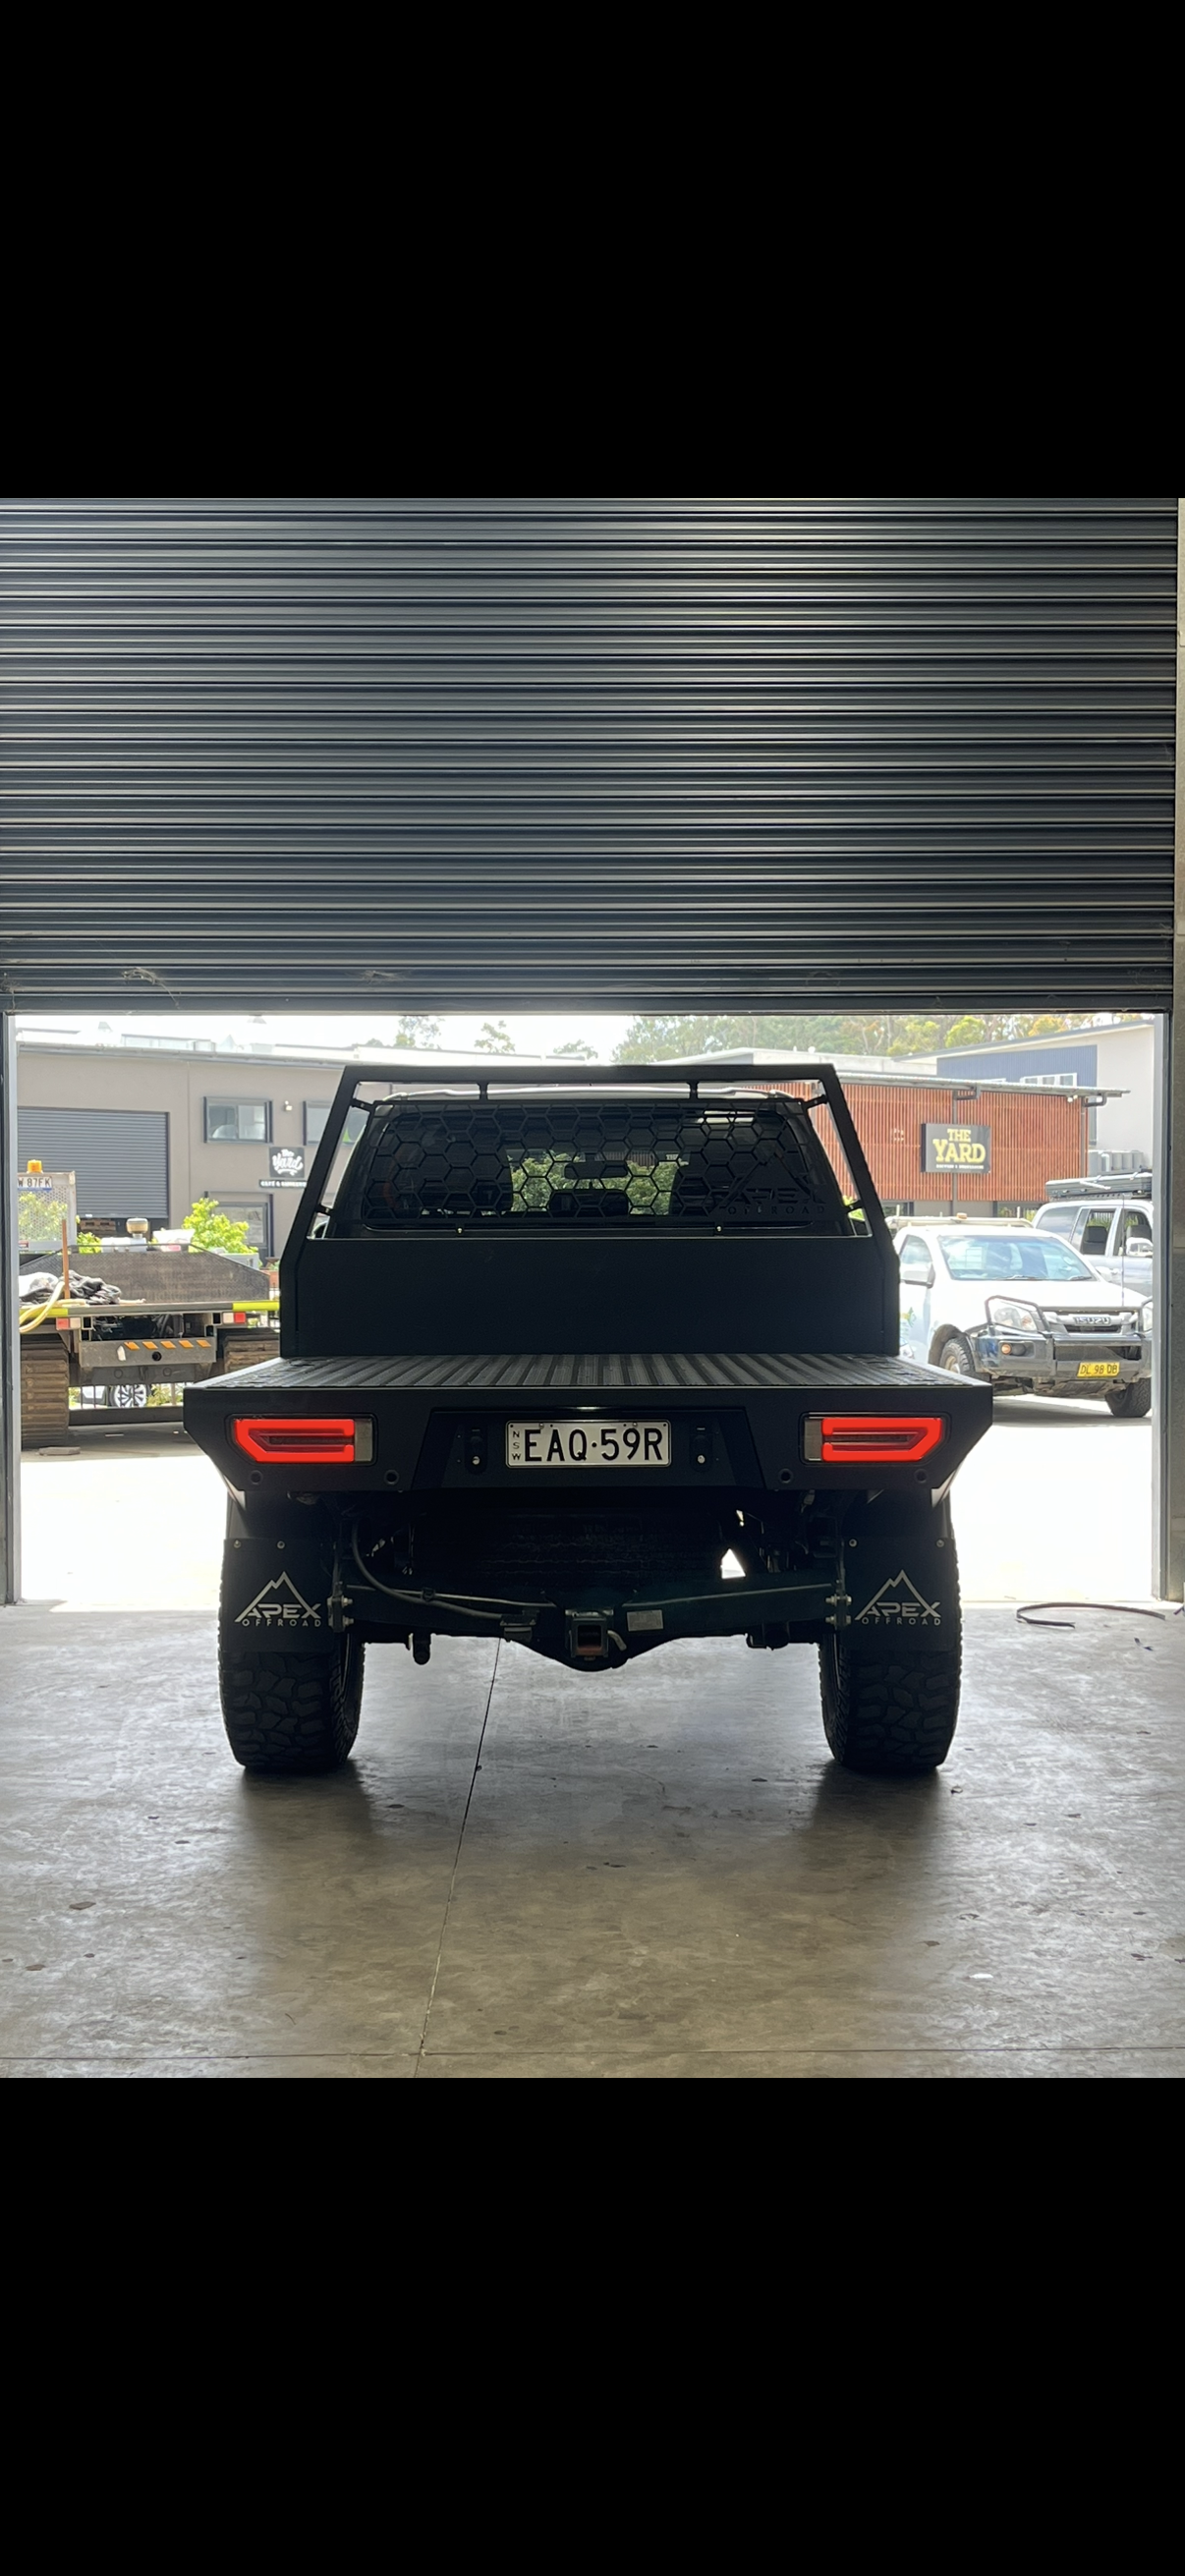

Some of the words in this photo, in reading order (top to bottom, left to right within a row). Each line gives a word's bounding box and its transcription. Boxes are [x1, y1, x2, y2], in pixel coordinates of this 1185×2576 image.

[947, 1129, 971, 1142] THE
[932, 1139, 986, 1163] YARD
[1074, 1316, 1111, 1325] ISUZU
[235, 1603, 321, 1622] APEX
[855, 1601, 941, 1621] APEX
[242, 1618, 321, 1627] OFFROAD
[862, 1617, 941, 1626] OFFROAD
